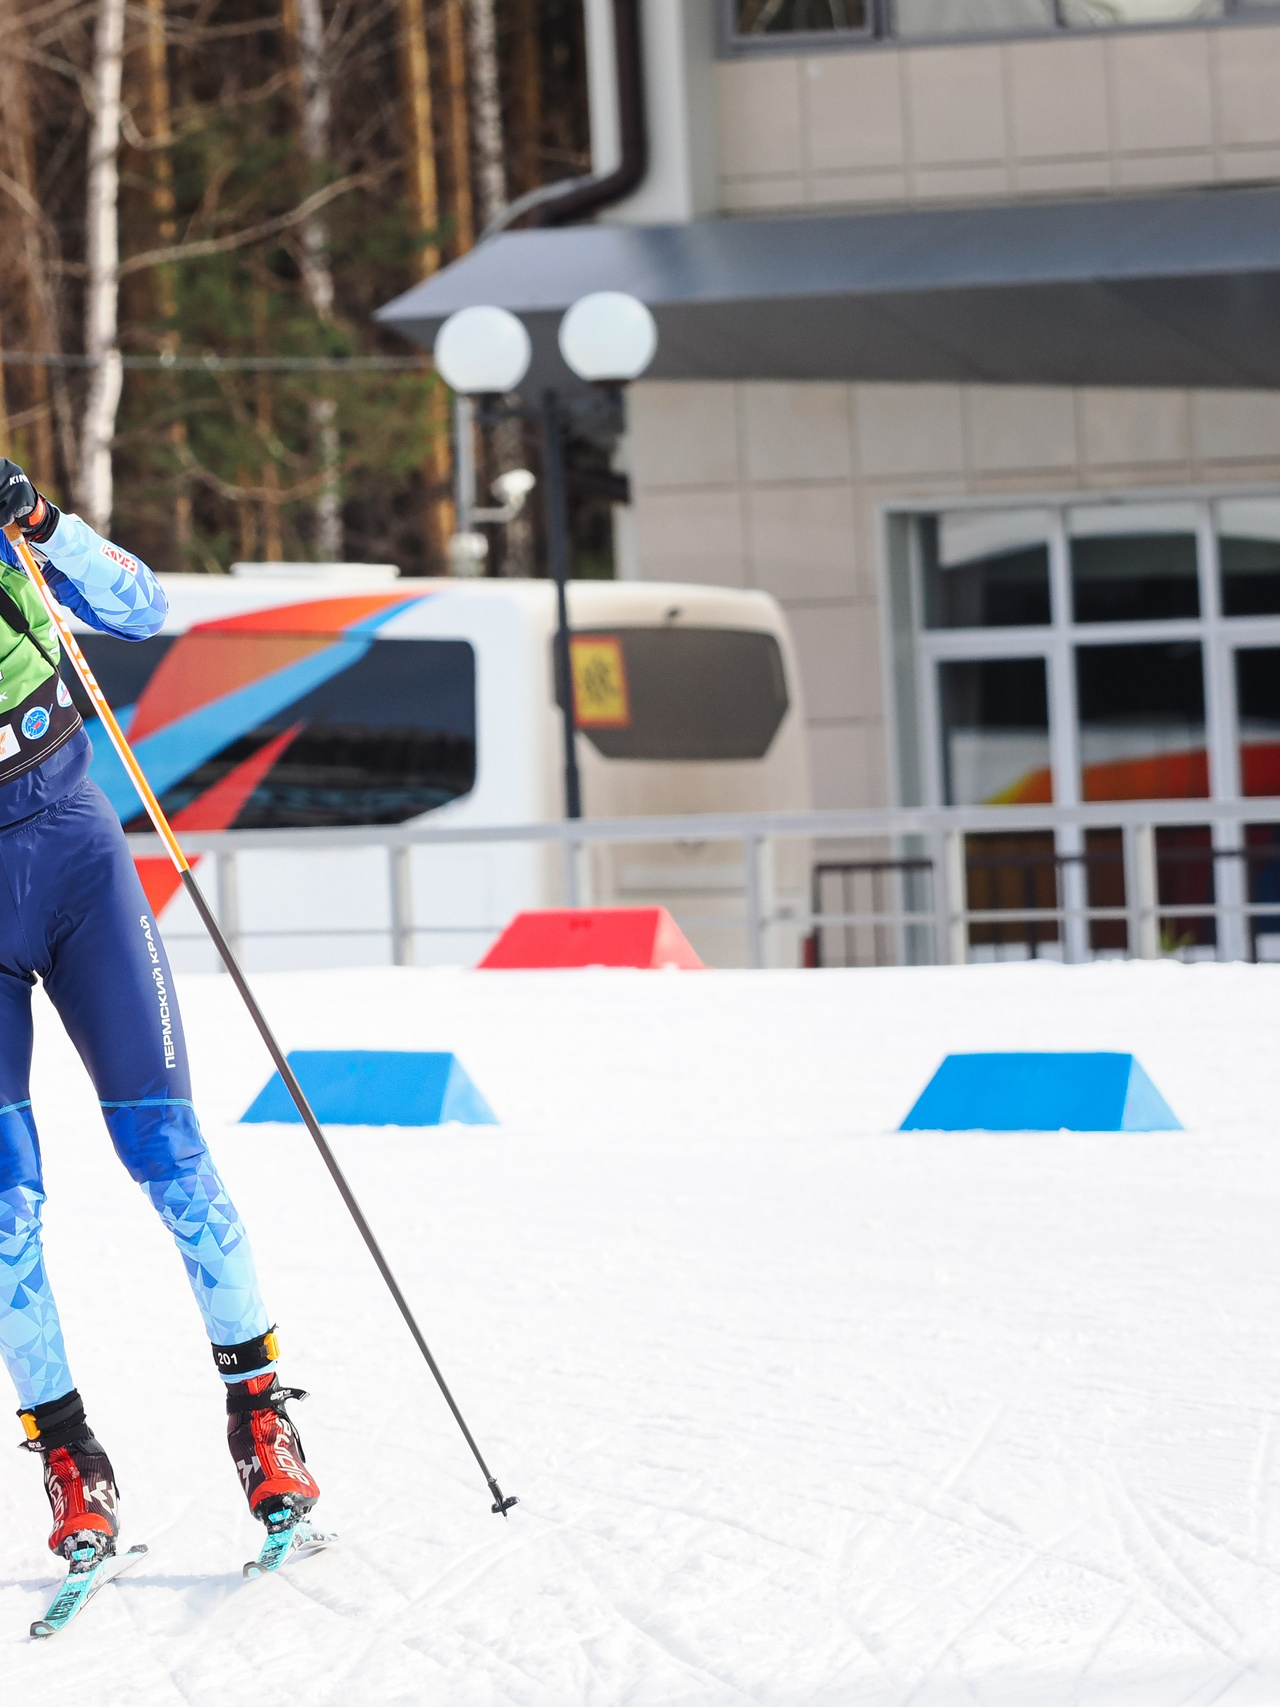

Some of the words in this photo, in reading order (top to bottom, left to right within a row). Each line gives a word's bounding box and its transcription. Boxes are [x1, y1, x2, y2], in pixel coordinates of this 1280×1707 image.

[140, 915, 160, 964] КРАЙ
[152, 967, 176, 1069] ПЕРМСКИЙ
[217, 1352, 238, 1366] 201
